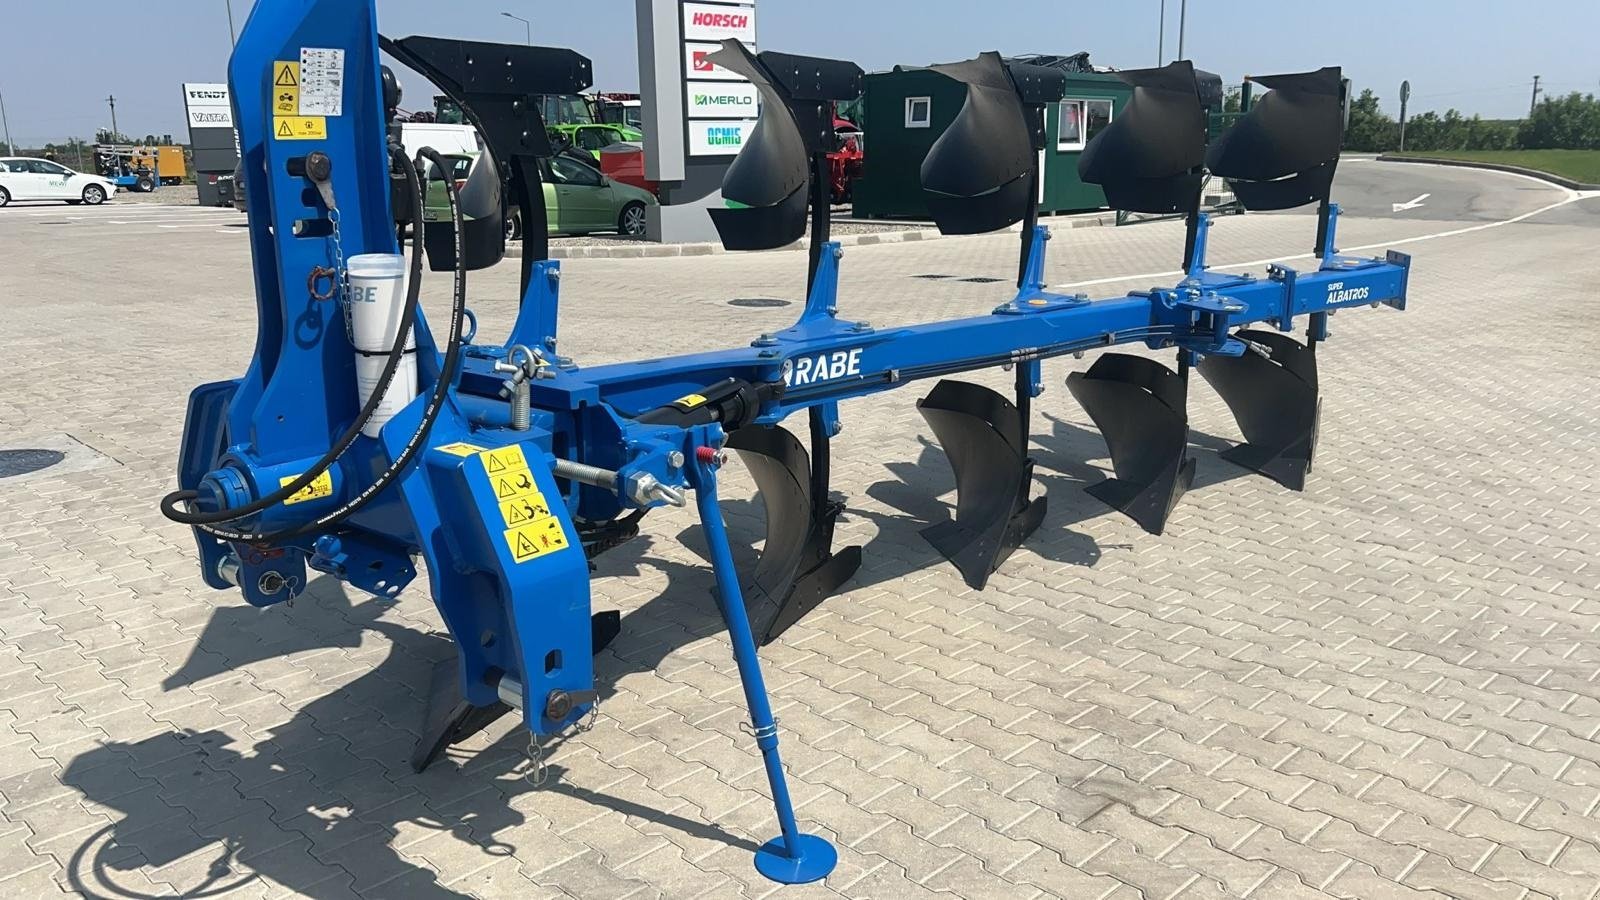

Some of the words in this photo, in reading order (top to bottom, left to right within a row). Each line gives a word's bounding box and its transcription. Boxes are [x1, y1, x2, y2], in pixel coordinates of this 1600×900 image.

[692, 12, 748, 28] HORSCH
[189, 90, 227, 99] FENDT
[709, 95, 752, 105] MERLO
[192, 112, 230, 122] VALTRA
[707, 127, 742, 145] OCMIS
[1327, 282, 1343, 291] SUPER
[1326, 286, 1370, 304] ALBATROS
[795, 348, 863, 385] RABE
